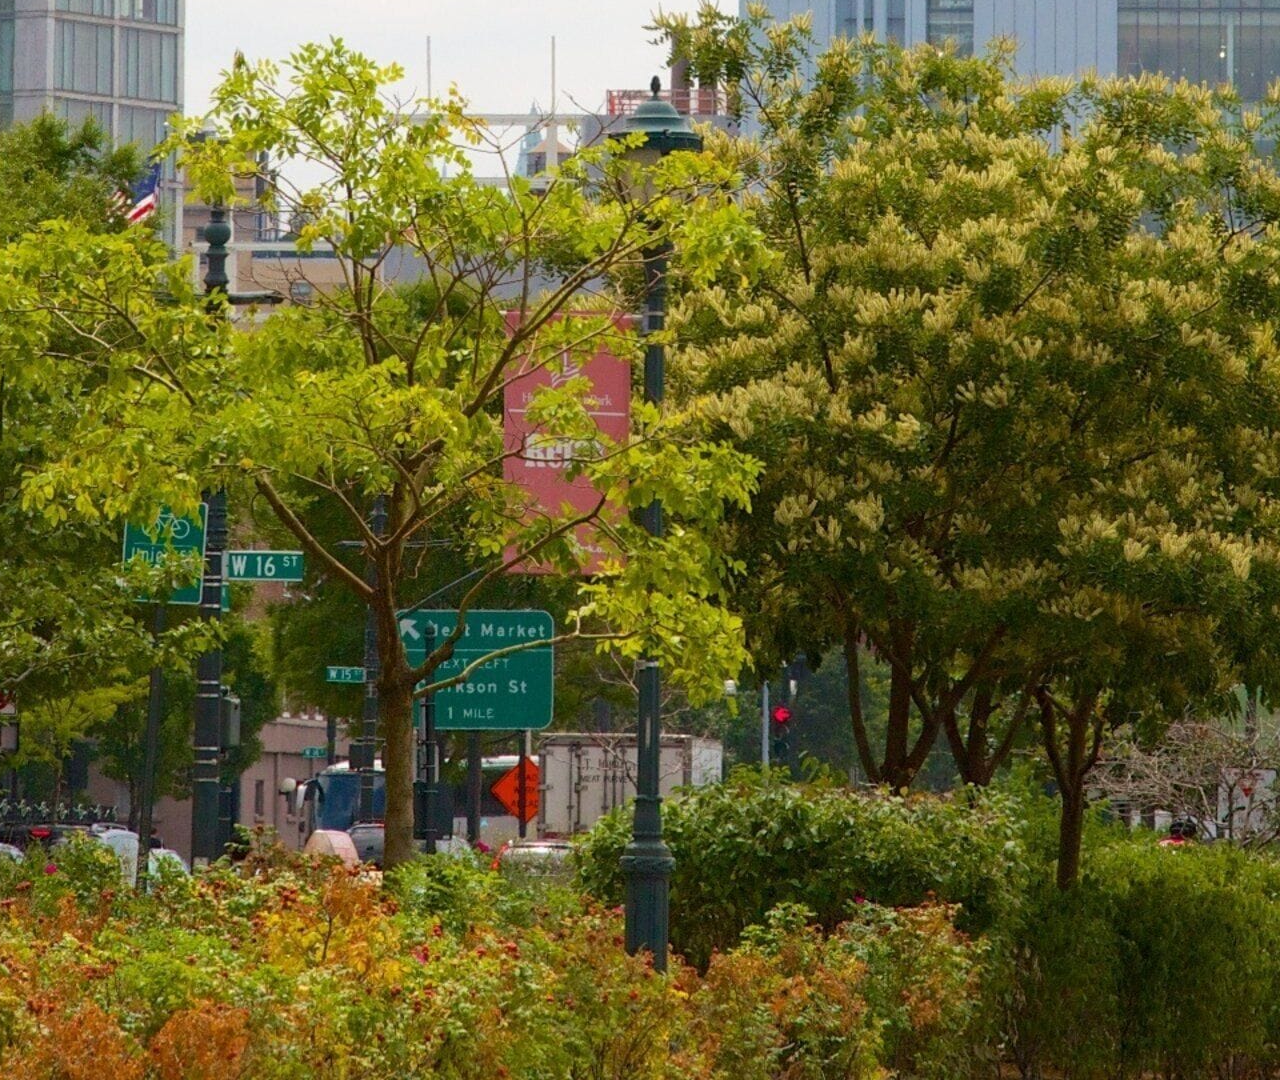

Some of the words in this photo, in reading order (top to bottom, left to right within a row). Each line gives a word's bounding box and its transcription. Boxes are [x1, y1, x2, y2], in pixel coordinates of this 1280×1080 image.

[231, 556, 247, 576] W
[256, 556, 276, 576] 16
[283, 556, 298, 567] ST
[480, 623, 546, 638] Market
[509, 680, 527, 694] St
[448, 707, 453, 719] 1
[463, 708, 495, 719] MILE
